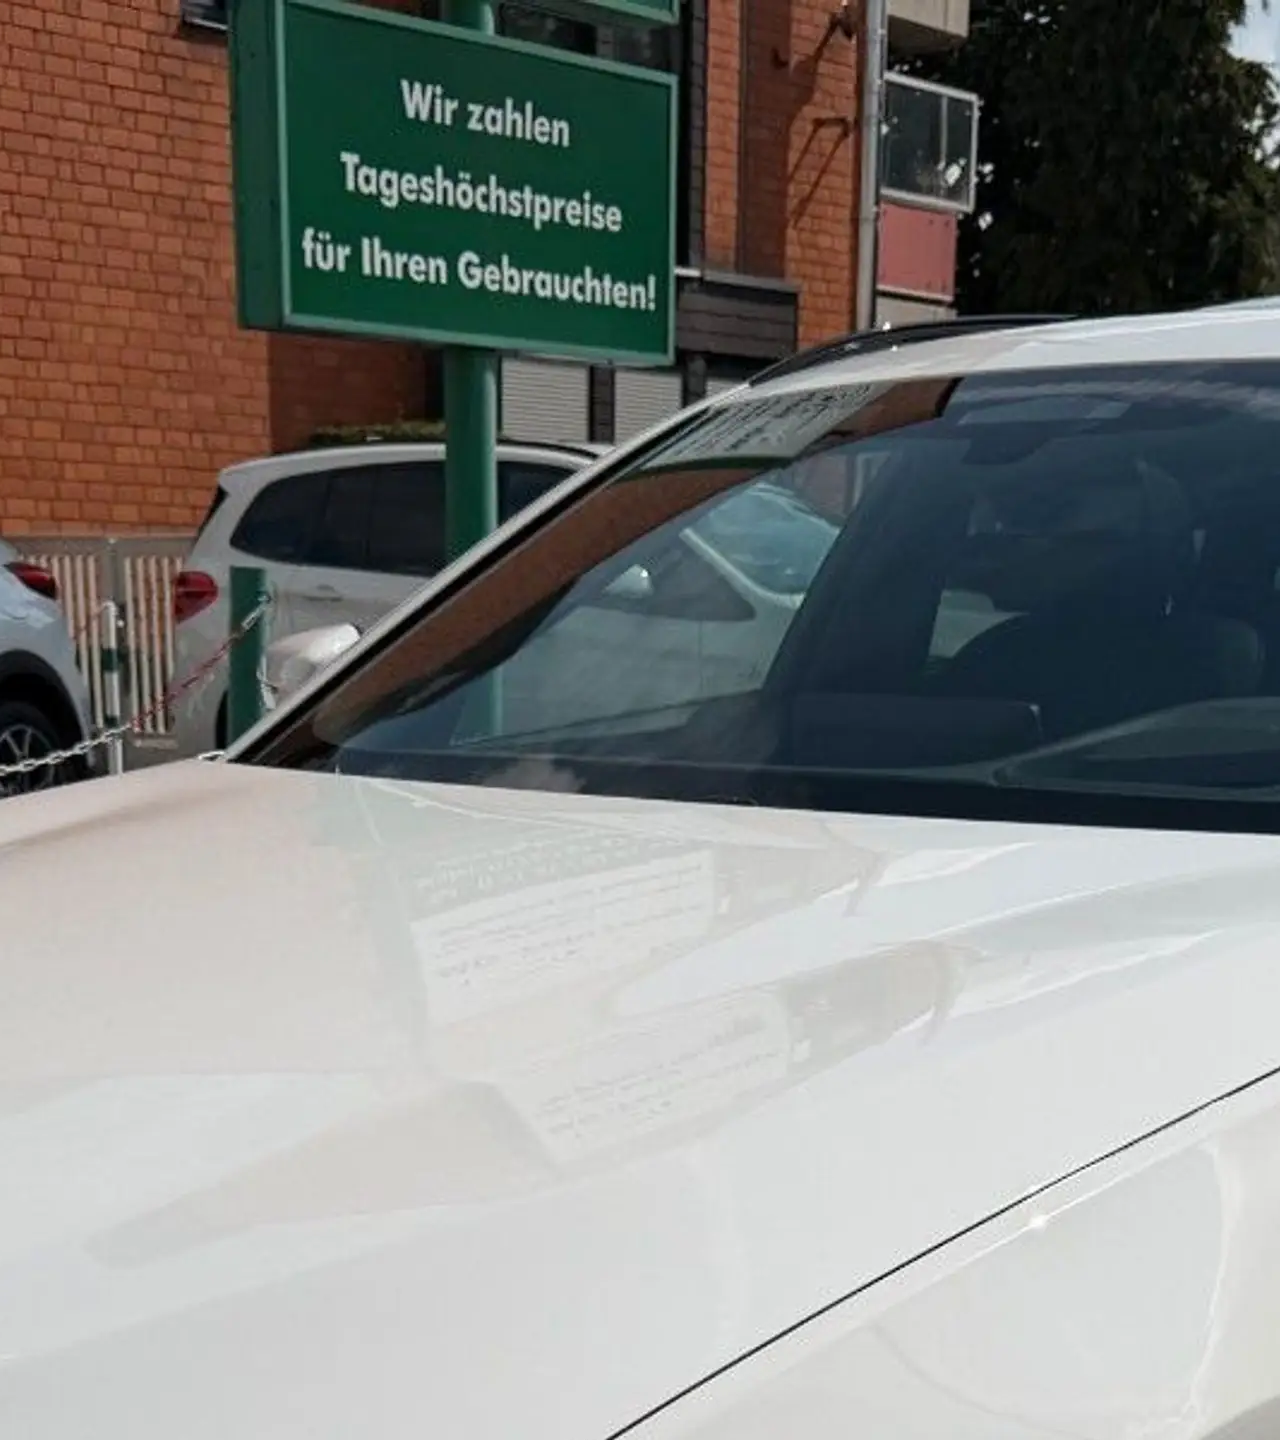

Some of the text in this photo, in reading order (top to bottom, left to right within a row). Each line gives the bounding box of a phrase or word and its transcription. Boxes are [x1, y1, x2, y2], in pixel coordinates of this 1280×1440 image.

[400, 78, 571, 148] Wir zahlen
[339, 151, 623, 233] Tageshöchstpreise
[301, 227, 657, 312] für Ihren Gebrauchten!
